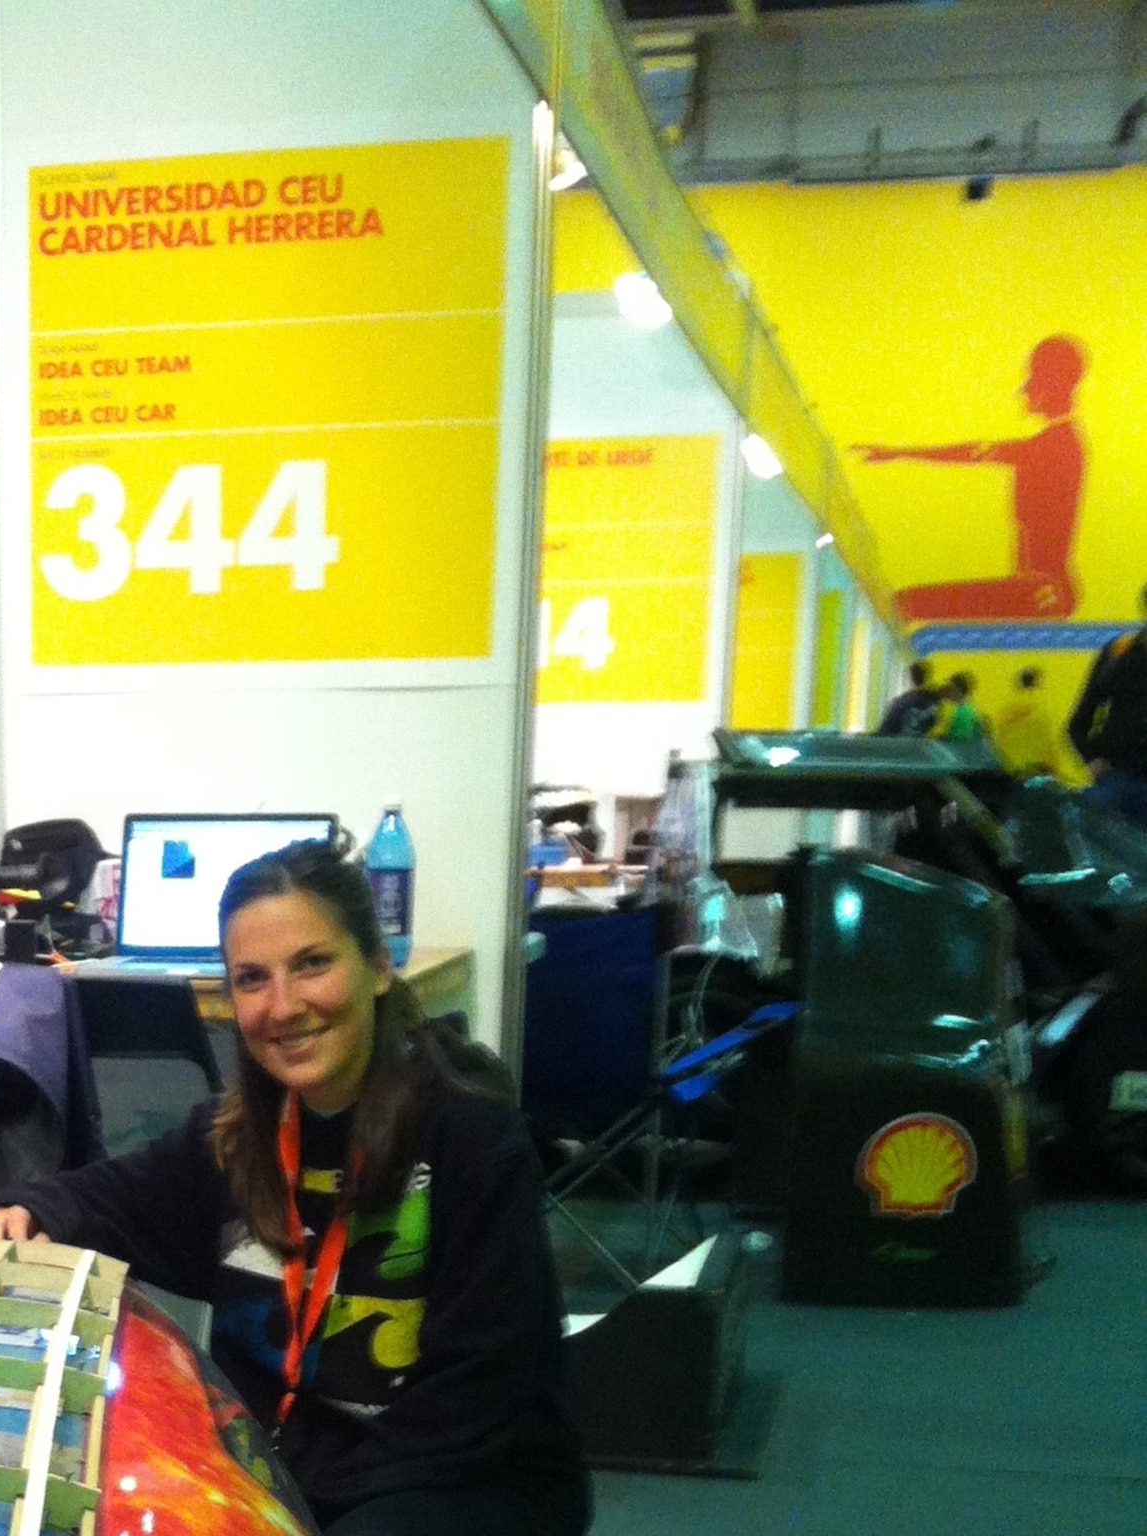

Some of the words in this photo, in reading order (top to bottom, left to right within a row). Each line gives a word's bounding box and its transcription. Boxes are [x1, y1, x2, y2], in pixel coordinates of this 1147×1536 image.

[39, 179, 267, 222] UNIVERSIDAD
[278, 173, 344, 206] CEU
[39, 217, 216, 257] CARDENAL
[227, 208, 384, 245] HERRERA
[38, 362, 83, 379] IDEA
[91, 359, 128, 377] CEU
[137, 355, 191, 374] TEAM
[39, 408, 83, 426] IDEA
[90, 405, 128, 423] CEU
[136, 403, 176, 421] CAR
[39, 459, 341, 602] 344
